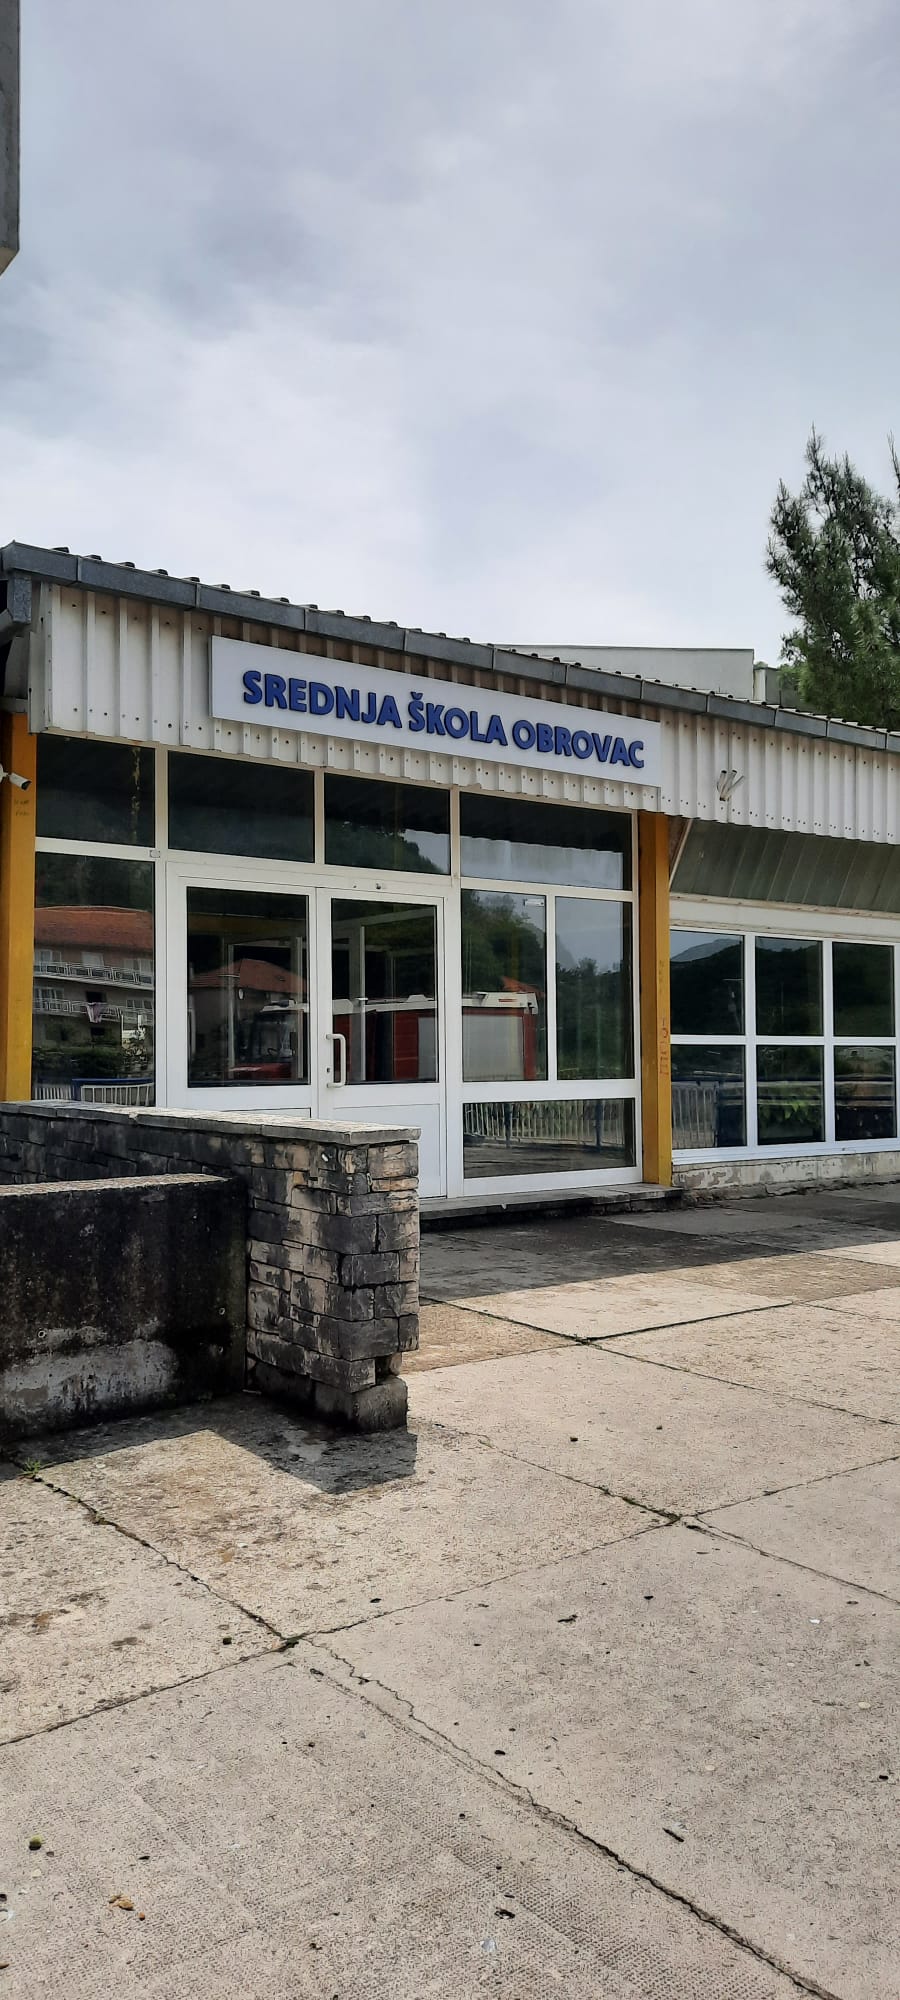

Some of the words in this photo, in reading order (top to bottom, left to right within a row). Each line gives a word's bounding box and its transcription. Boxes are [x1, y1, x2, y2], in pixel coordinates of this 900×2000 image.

[243, 670, 402, 729] SREDNJA
[408, 692, 508, 746] ŠKOLA
[512, 720, 645, 769] OBROVAC
